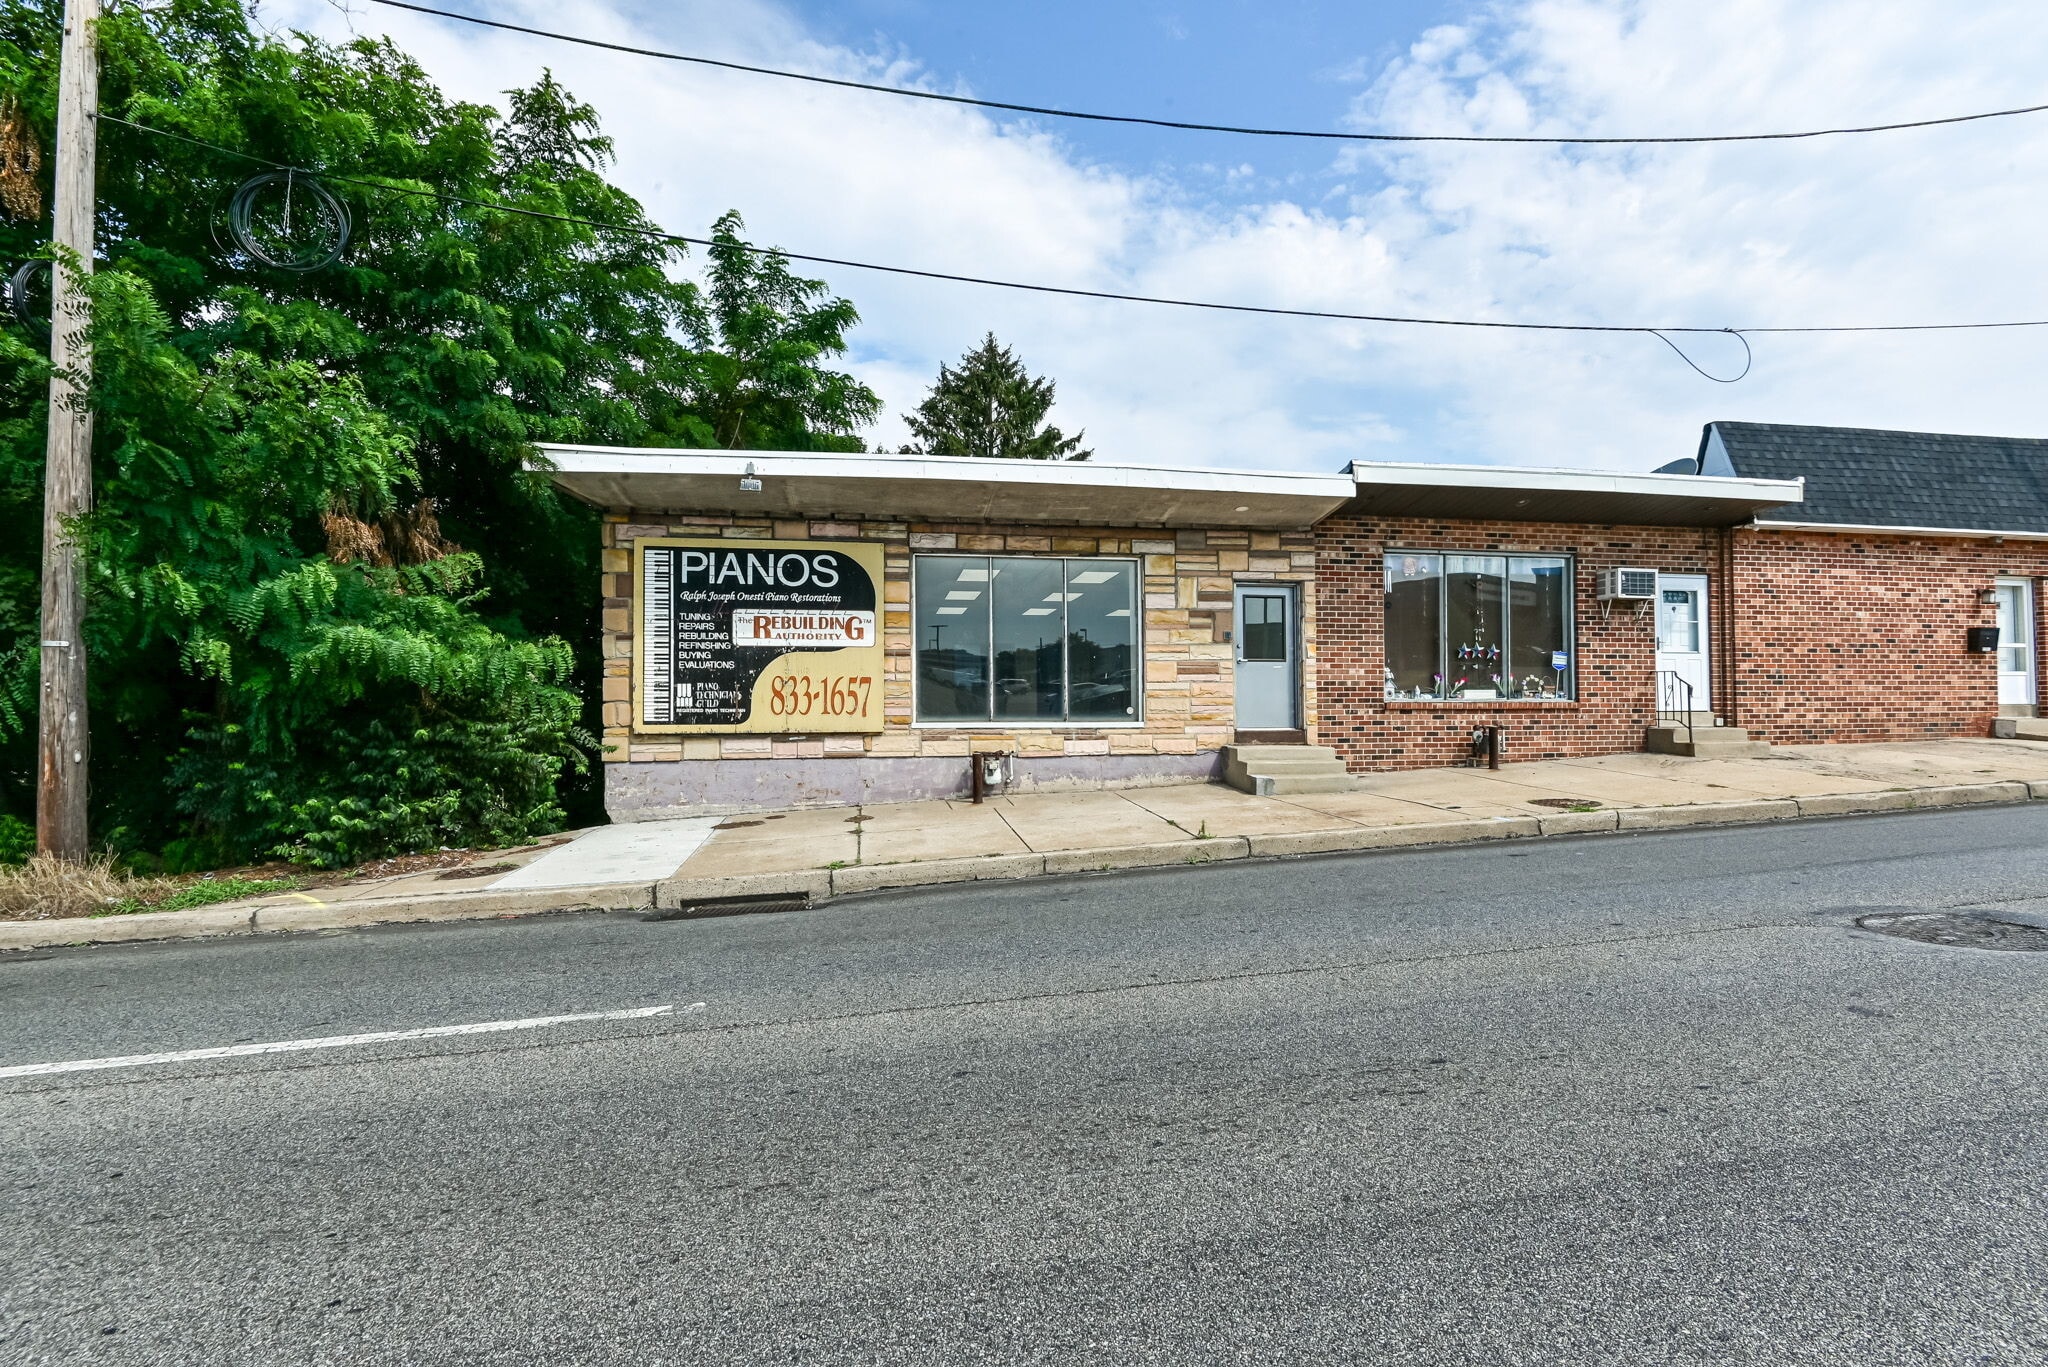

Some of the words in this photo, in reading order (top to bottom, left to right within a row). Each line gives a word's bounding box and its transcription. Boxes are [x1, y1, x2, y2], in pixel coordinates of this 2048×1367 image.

[681, 551, 840, 588] PIANOS
[680, 590, 707, 602] Ralph
[707, 591, 736, 603] Joseph
[736, 592, 765, 601] Onesti
[765, 592, 790, 603] Piano
[790, 592, 842, 603] Restorations
[679, 612, 711, 621] TUNING
[679, 622, 715, 631] REPAIRS
[679, 632, 729, 640] REBUILDING
[775, 632, 842, 641] AUTHORITY
[679, 641, 732, 650] REFINISHING
[679, 651, 712, 660] BUYING
[679, 661, 735, 670] EVALUATIONS
[696, 682, 719, 691] PIANO
[770, 675, 872, 718] 833-1657
[696, 699, 719, 708] GUILD
